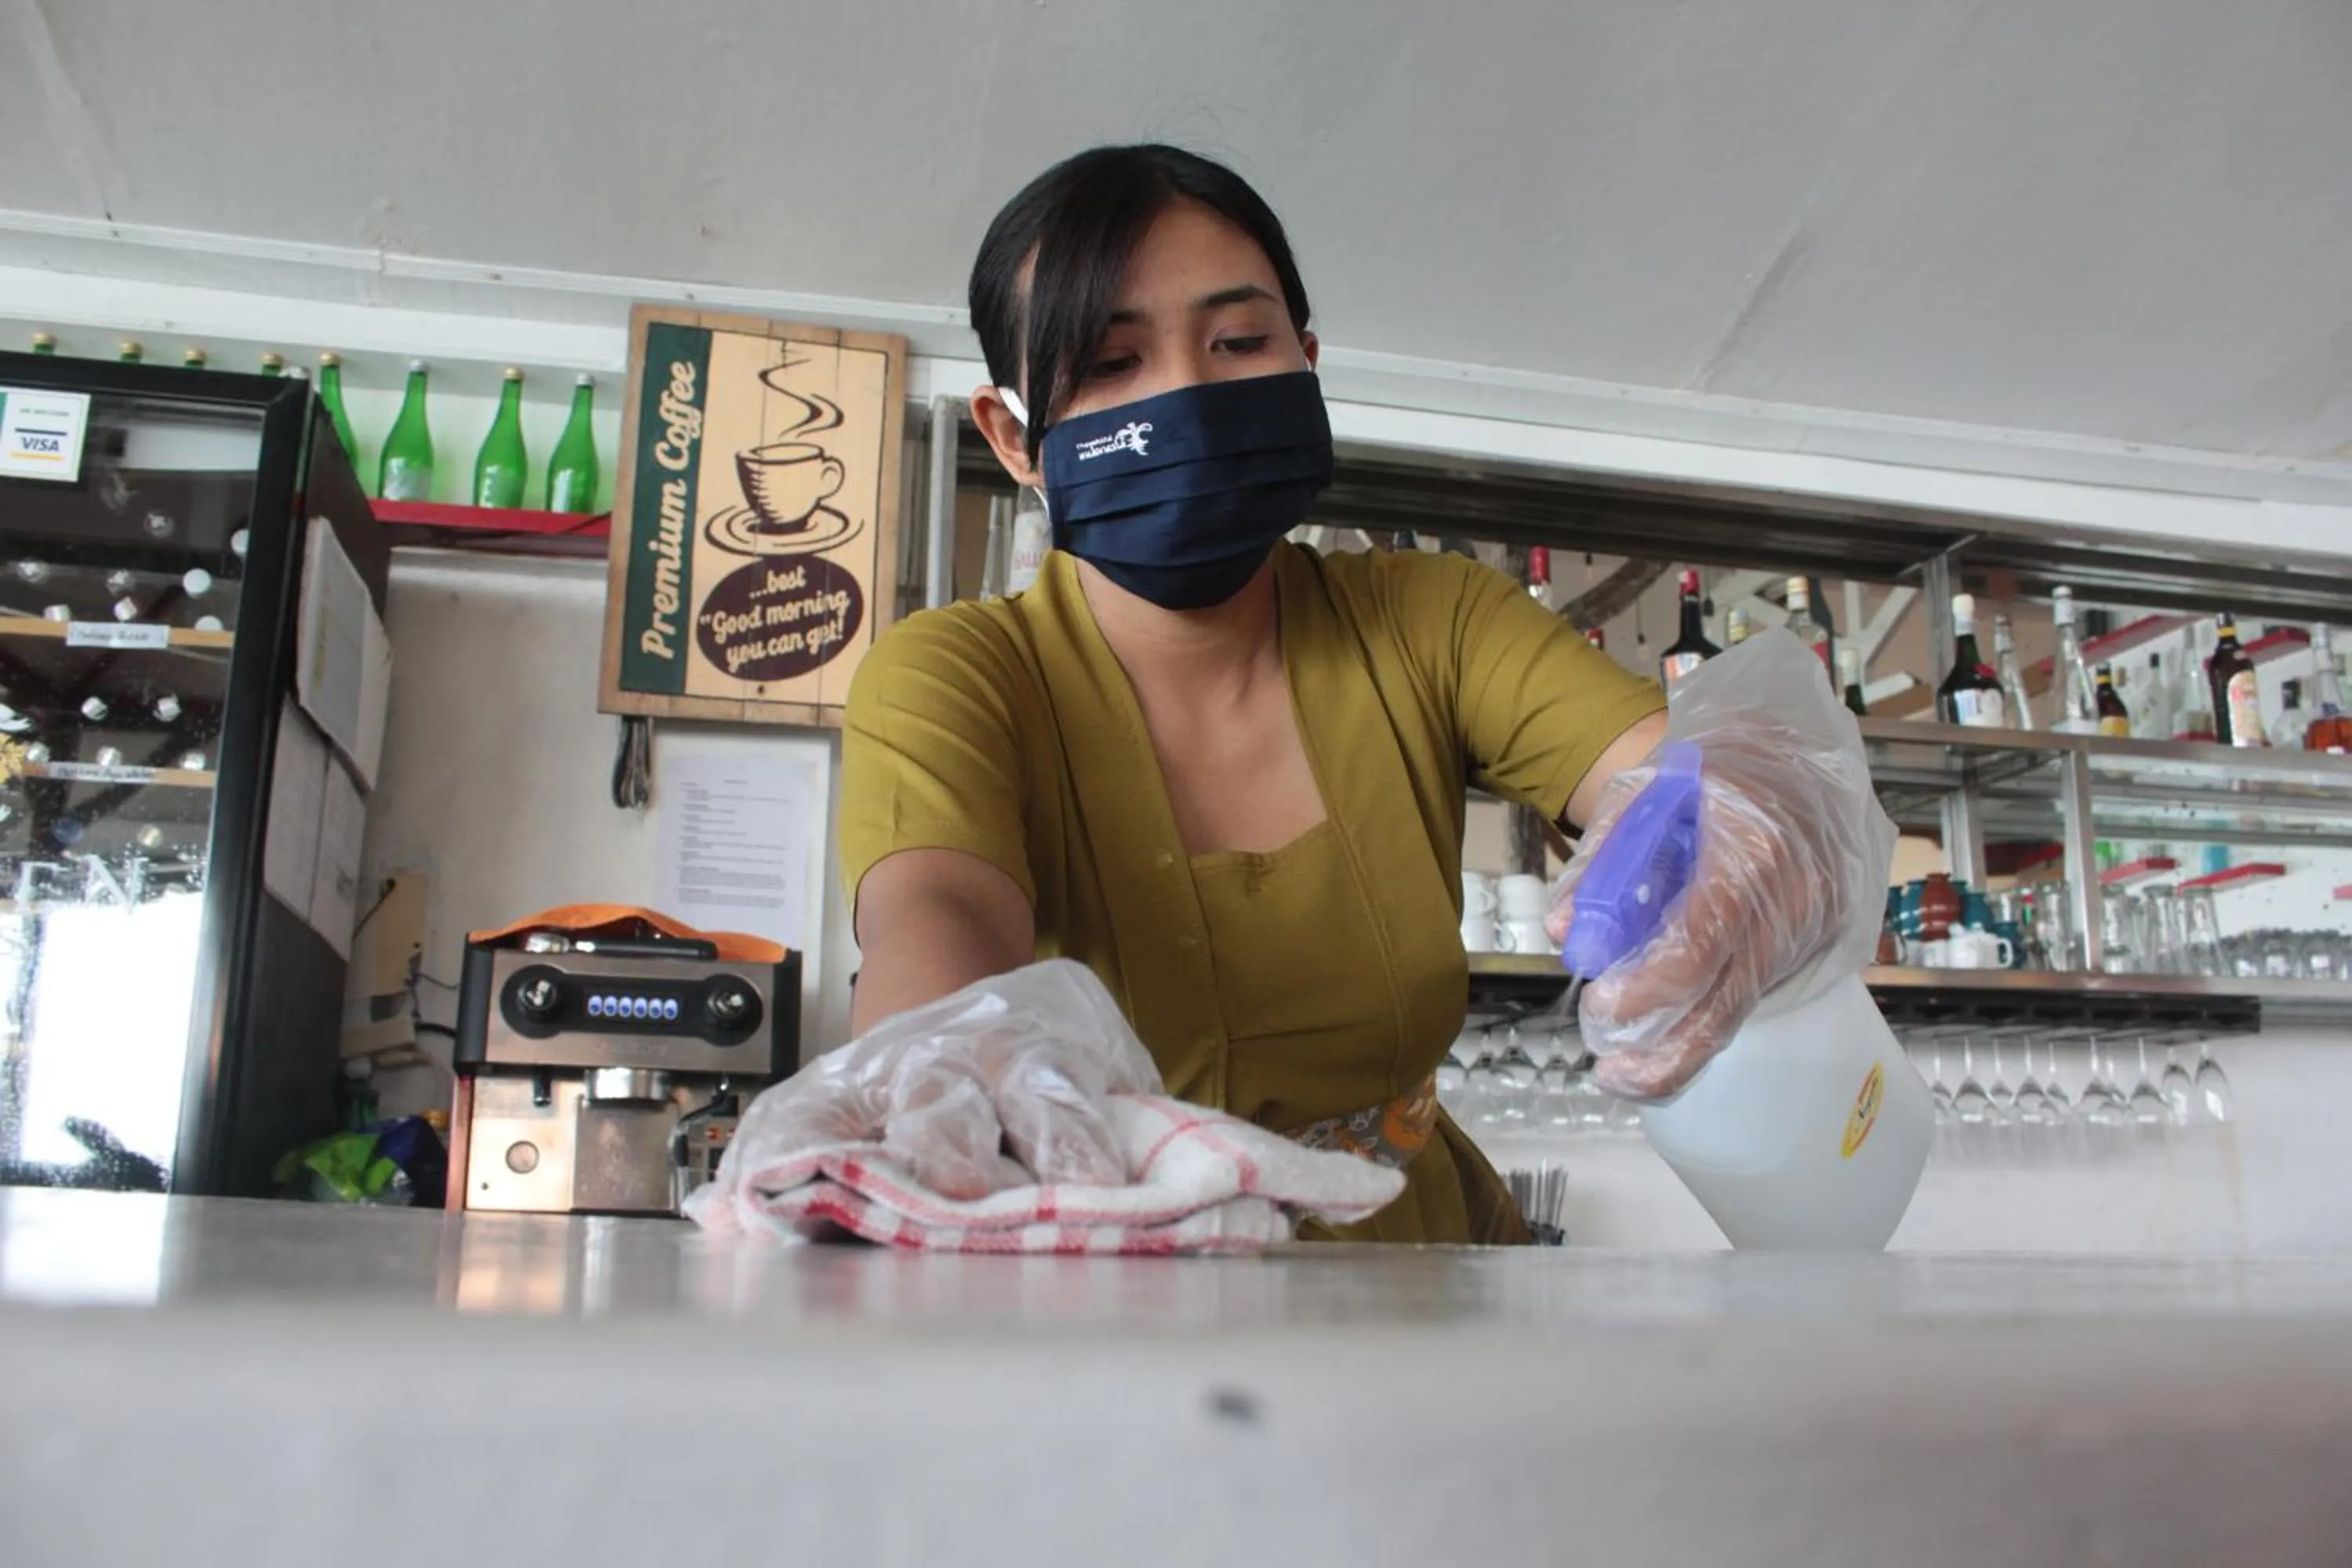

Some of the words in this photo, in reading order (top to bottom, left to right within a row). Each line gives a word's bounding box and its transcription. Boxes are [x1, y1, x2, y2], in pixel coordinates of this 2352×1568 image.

[655, 360, 702, 471] Coffee
[21, 437, 60, 452] VISA
[641, 477, 688, 660] Premium
[766, 589, 851, 626] morning
[725, 641, 766, 673] you
[767, 631, 804, 656] can
[805, 616, 845, 655] get!
